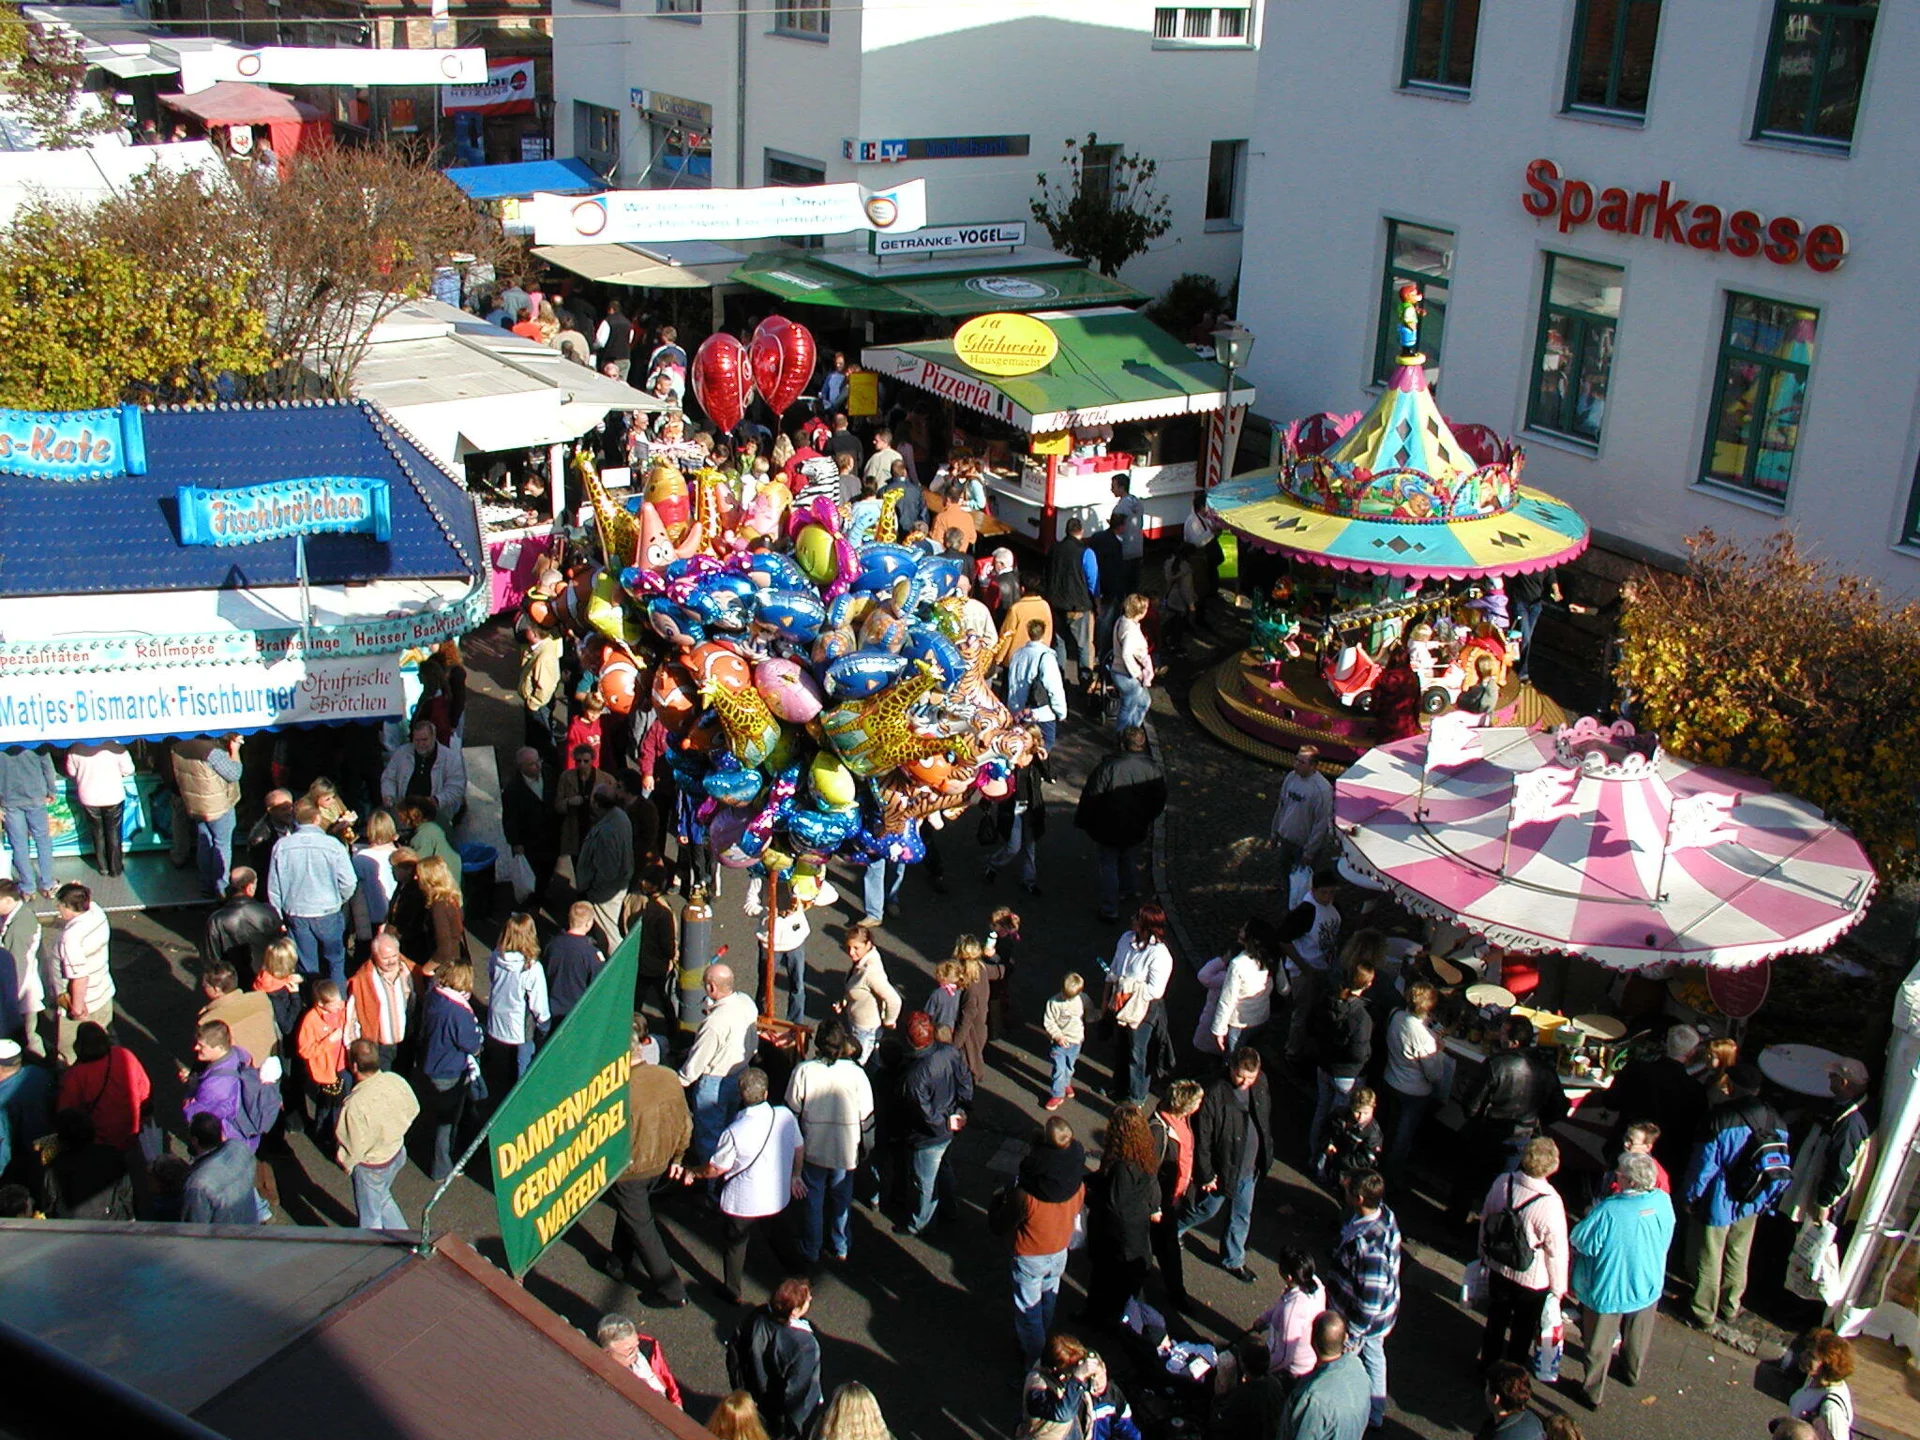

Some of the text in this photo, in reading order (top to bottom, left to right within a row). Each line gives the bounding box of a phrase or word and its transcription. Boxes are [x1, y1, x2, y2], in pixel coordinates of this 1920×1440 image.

[1522, 158, 1850, 272] Sparkasse
[963, 332, 1047, 355] Glühwein
[970, 354, 1042, 367] Hausgemacht
[920, 361, 992, 410] Pizzeria
[211, 486, 365, 536] Fischbrötchen
[355, 631, 407, 647] Heisser
[301, 668, 393, 699] Ofenfrische
[310, 693, 387, 714] Brötchen
[497, 1050, 632, 1179] DAMPFNUDELN
[512, 1100, 627, 1219] GERMKNÖDEL
[535, 1155, 608, 1246] WAFFELN
